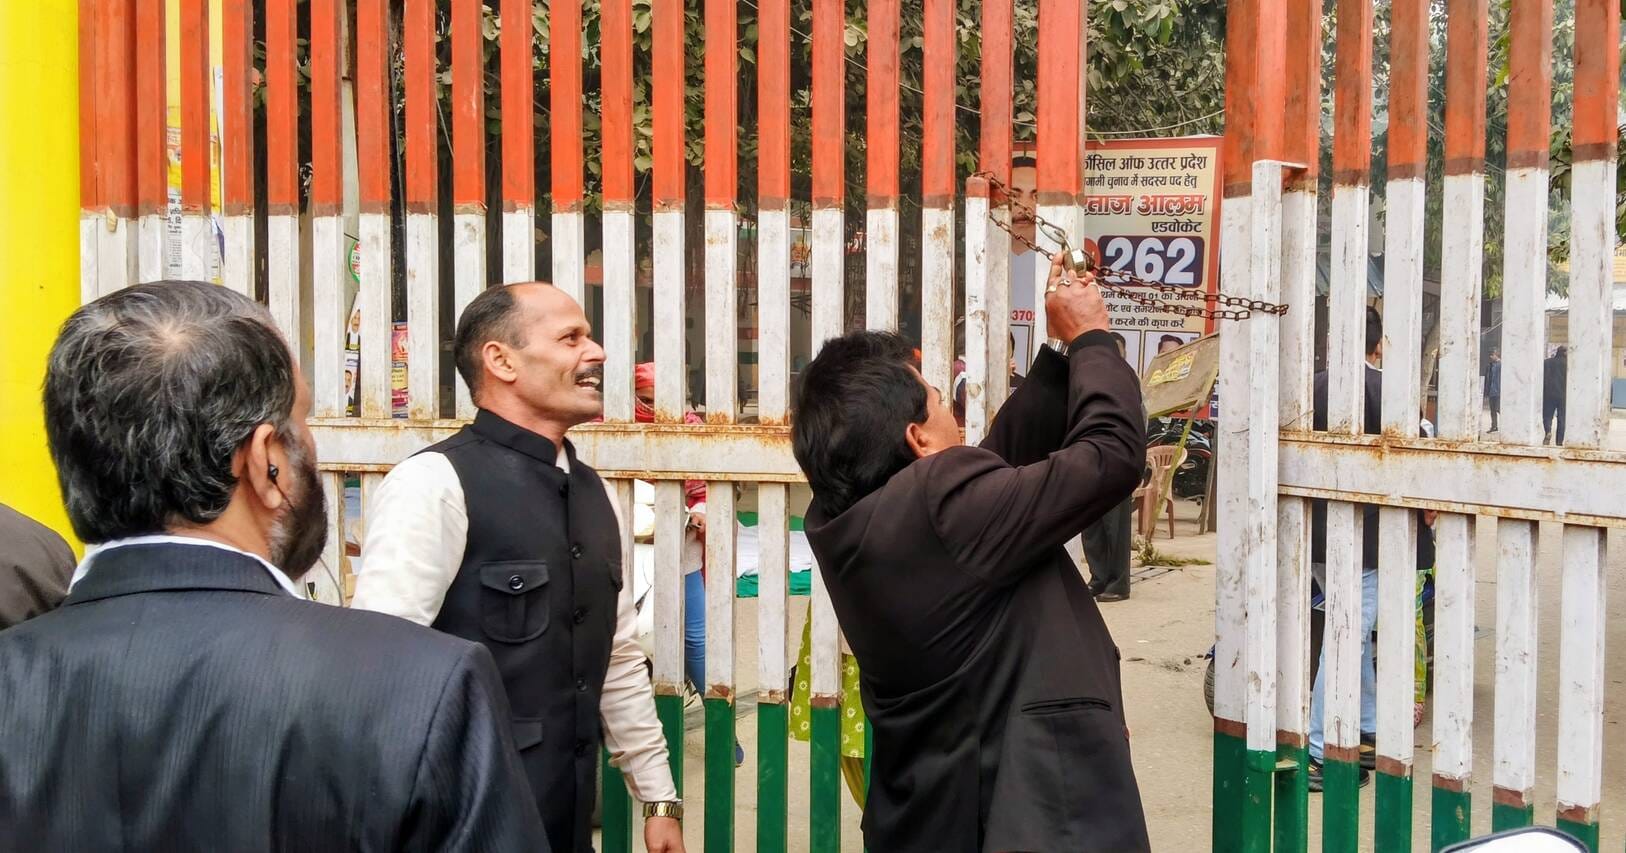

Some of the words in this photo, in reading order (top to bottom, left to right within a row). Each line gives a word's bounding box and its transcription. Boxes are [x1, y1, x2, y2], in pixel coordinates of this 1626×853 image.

[1147, 155, 1178, 170] उत्तर
[1180, 152, 1208, 171] प्रदेश
[1107, 175, 1129, 190] चुनाव
[1130, 173, 1139, 187] में
[1140, 175, 1167, 188] सदस्य
[1169, 175, 1182, 187] पद
[1184, 172, 1198, 189] हेतु
[1137, 193, 1207, 217] आलम
[1151, 219, 1203, 233] एडवोकेट
[1104, 236, 1196, 285] 262
[1120, 302, 1132, 313] एवं
[1114, 317, 1136, 327] करने
[1137, 317, 1149, 327] की
[1151, 319, 1169, 329] कृपा
